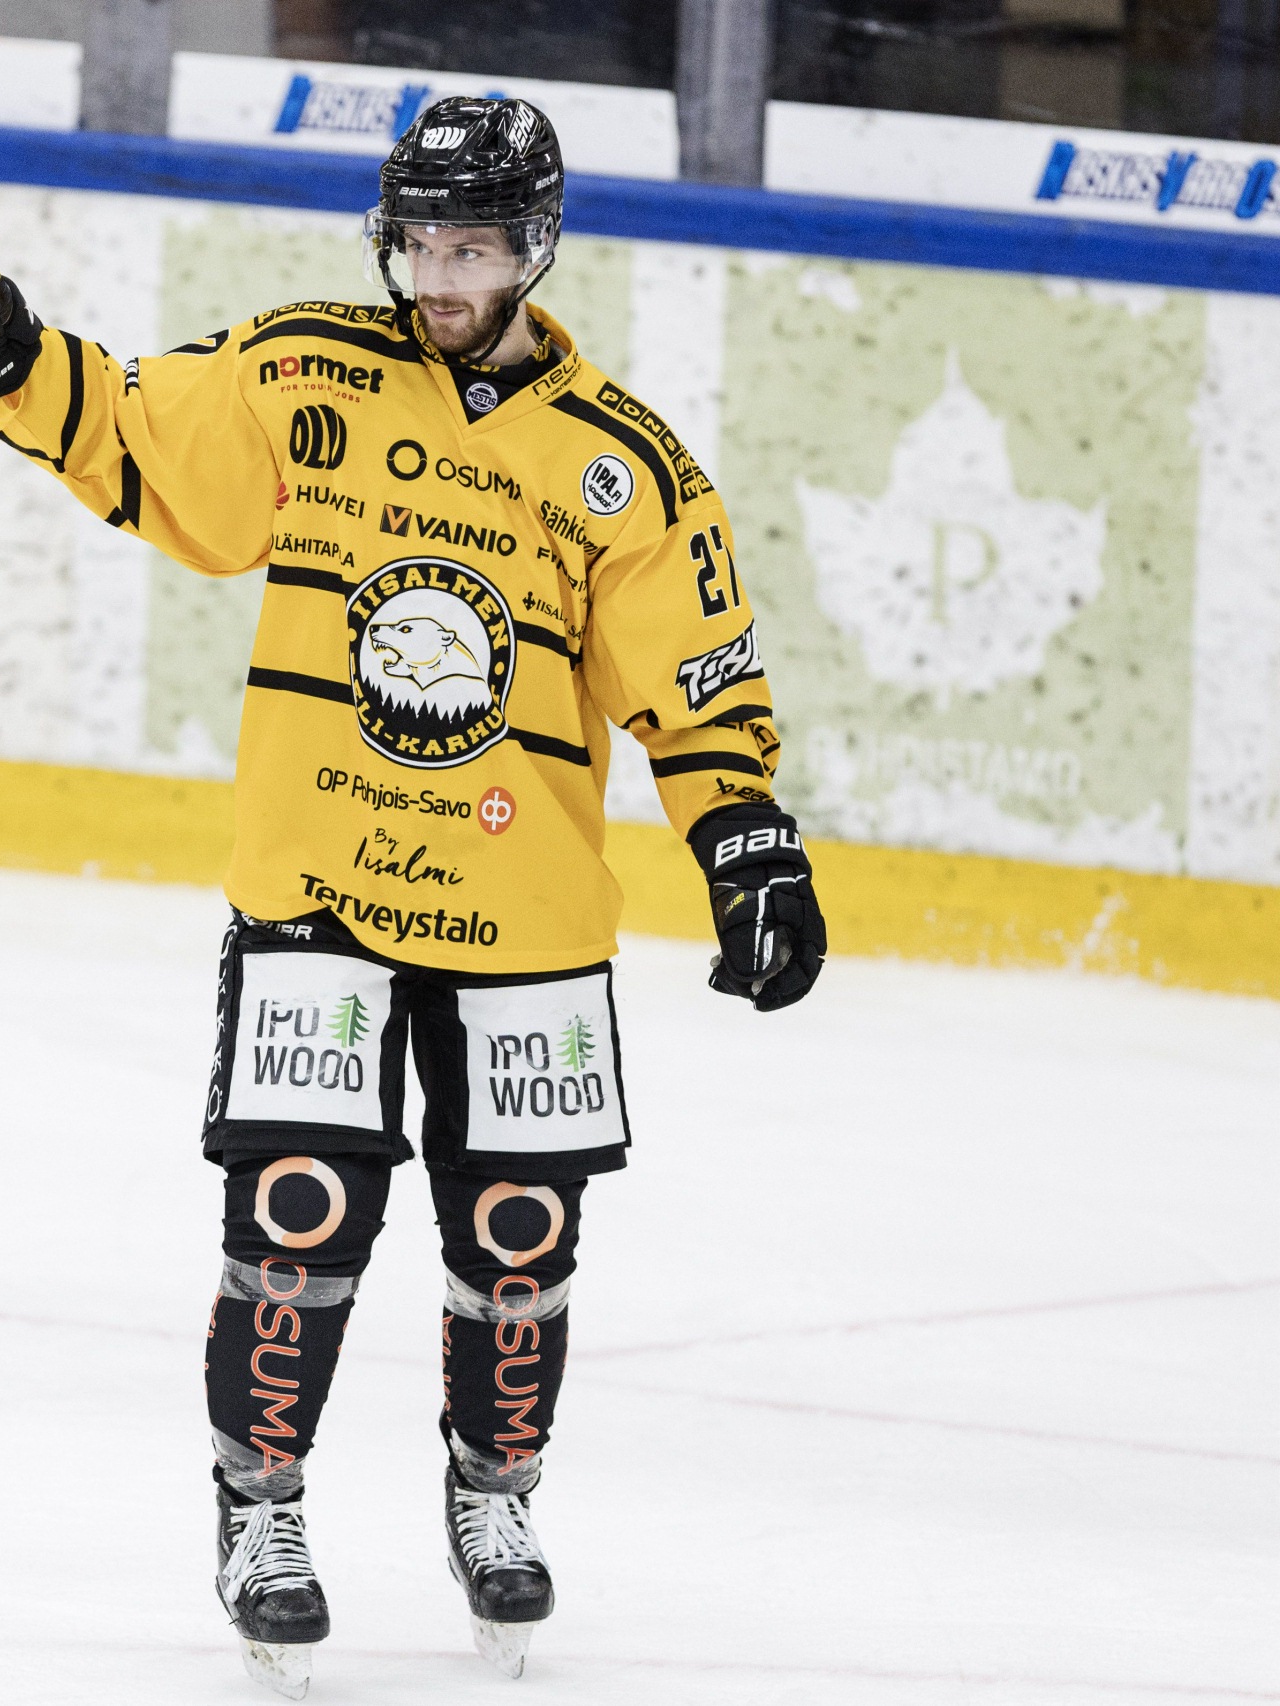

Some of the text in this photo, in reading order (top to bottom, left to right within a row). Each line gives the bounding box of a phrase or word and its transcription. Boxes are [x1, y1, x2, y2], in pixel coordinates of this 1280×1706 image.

[398, 186, 451, 199] BAUER
[255, 302, 397, 329] PONSSE
[259, 354, 385, 395] normet
[280, 384, 299, 394] FOR
[335, 390, 361, 404] JOBS
[598, 384, 699, 500] PONSSE
[296, 484, 366, 519] HUEI
[415, 513, 517, 557] VAINIO
[688, 523, 741, 620] 27
[351, 566, 509, 651] IISALMEN
[316, 767, 472, 819] OP Pohjois-Savo
[353, 836, 465, 886] Iisalmi
[374, 827, 400, 855] By
[300, 872, 499, 947] Terveystalo
[255, 997, 321, 1040] IPO
[254, 1044, 364, 1093] WOOD
[486, 1031, 551, 1071] IPO
[487, 1072, 605, 1118] WOOD
[249, 1255, 308, 1480] OSUMA
[491, 1274, 540, 1477] OSUMA
